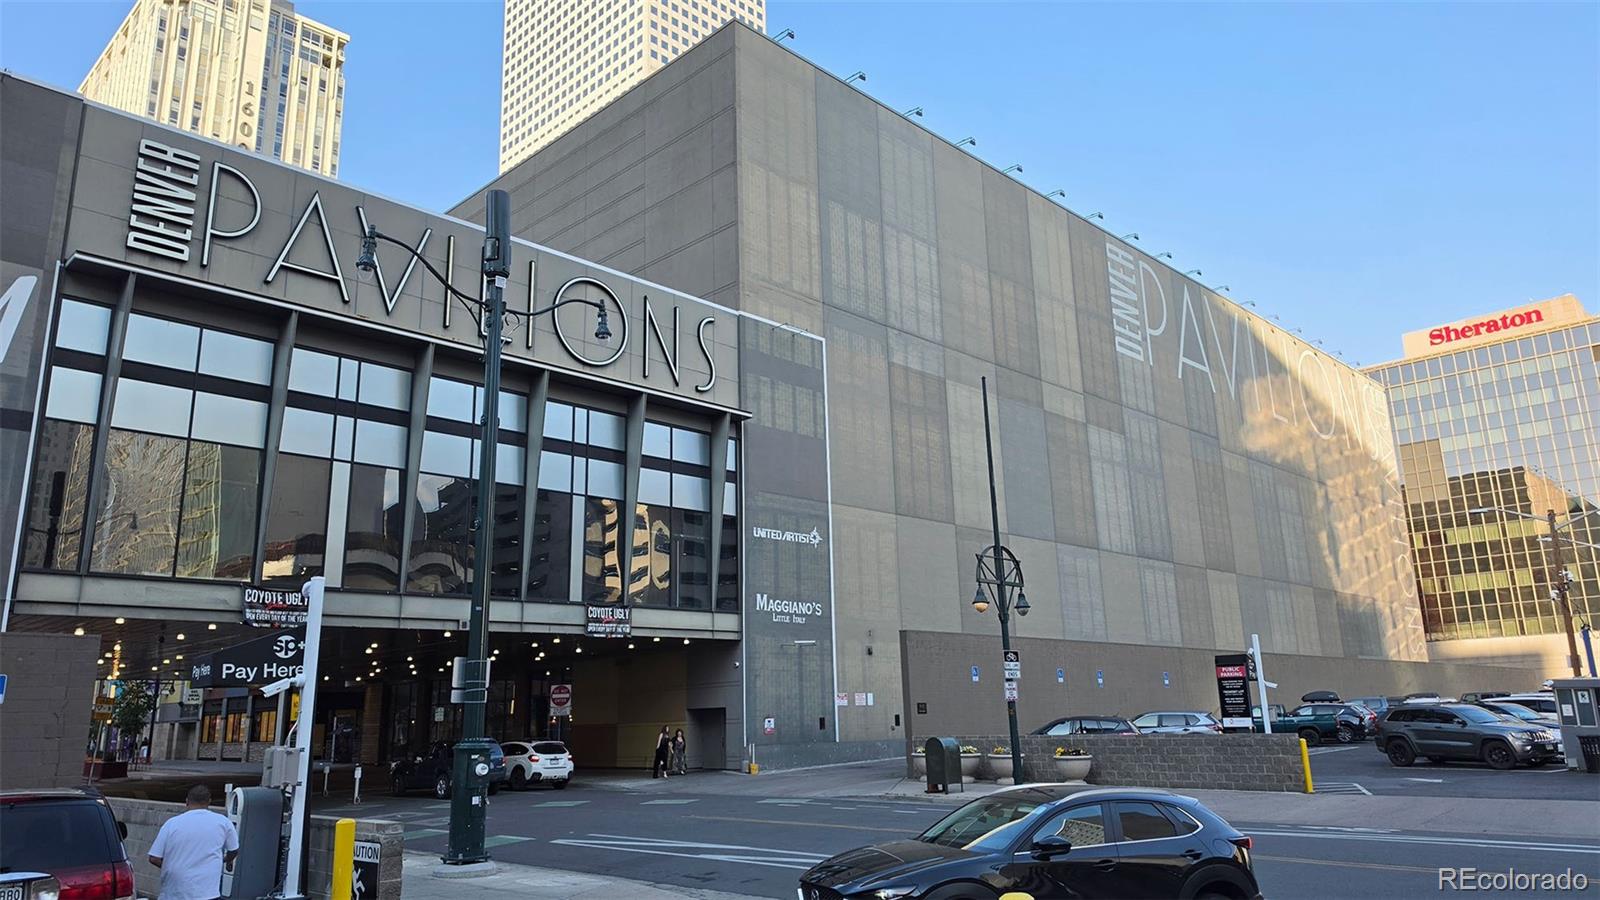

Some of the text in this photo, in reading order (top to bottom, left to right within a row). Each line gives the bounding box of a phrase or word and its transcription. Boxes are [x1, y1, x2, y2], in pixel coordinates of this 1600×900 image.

[126, 138, 200, 262] DENVER
[200, 160, 715, 393] PAVILIONS
[1105, 241, 1145, 362] DENVER
[1429, 306, 1543, 346] Sheraton
[753, 526, 816, 544] UNITED ARTISTS
[245, 588, 283, 604] COYOTE
[756, 593, 822, 616] MAGGIANO'S
[588, 606, 613, 619] COYOTE
[613, 607, 630, 620] UGLY
[192, 663, 211, 681] Pay Here
[222, 663, 305, 682] Pay Here
[355, 845, 380, 860] UTION
